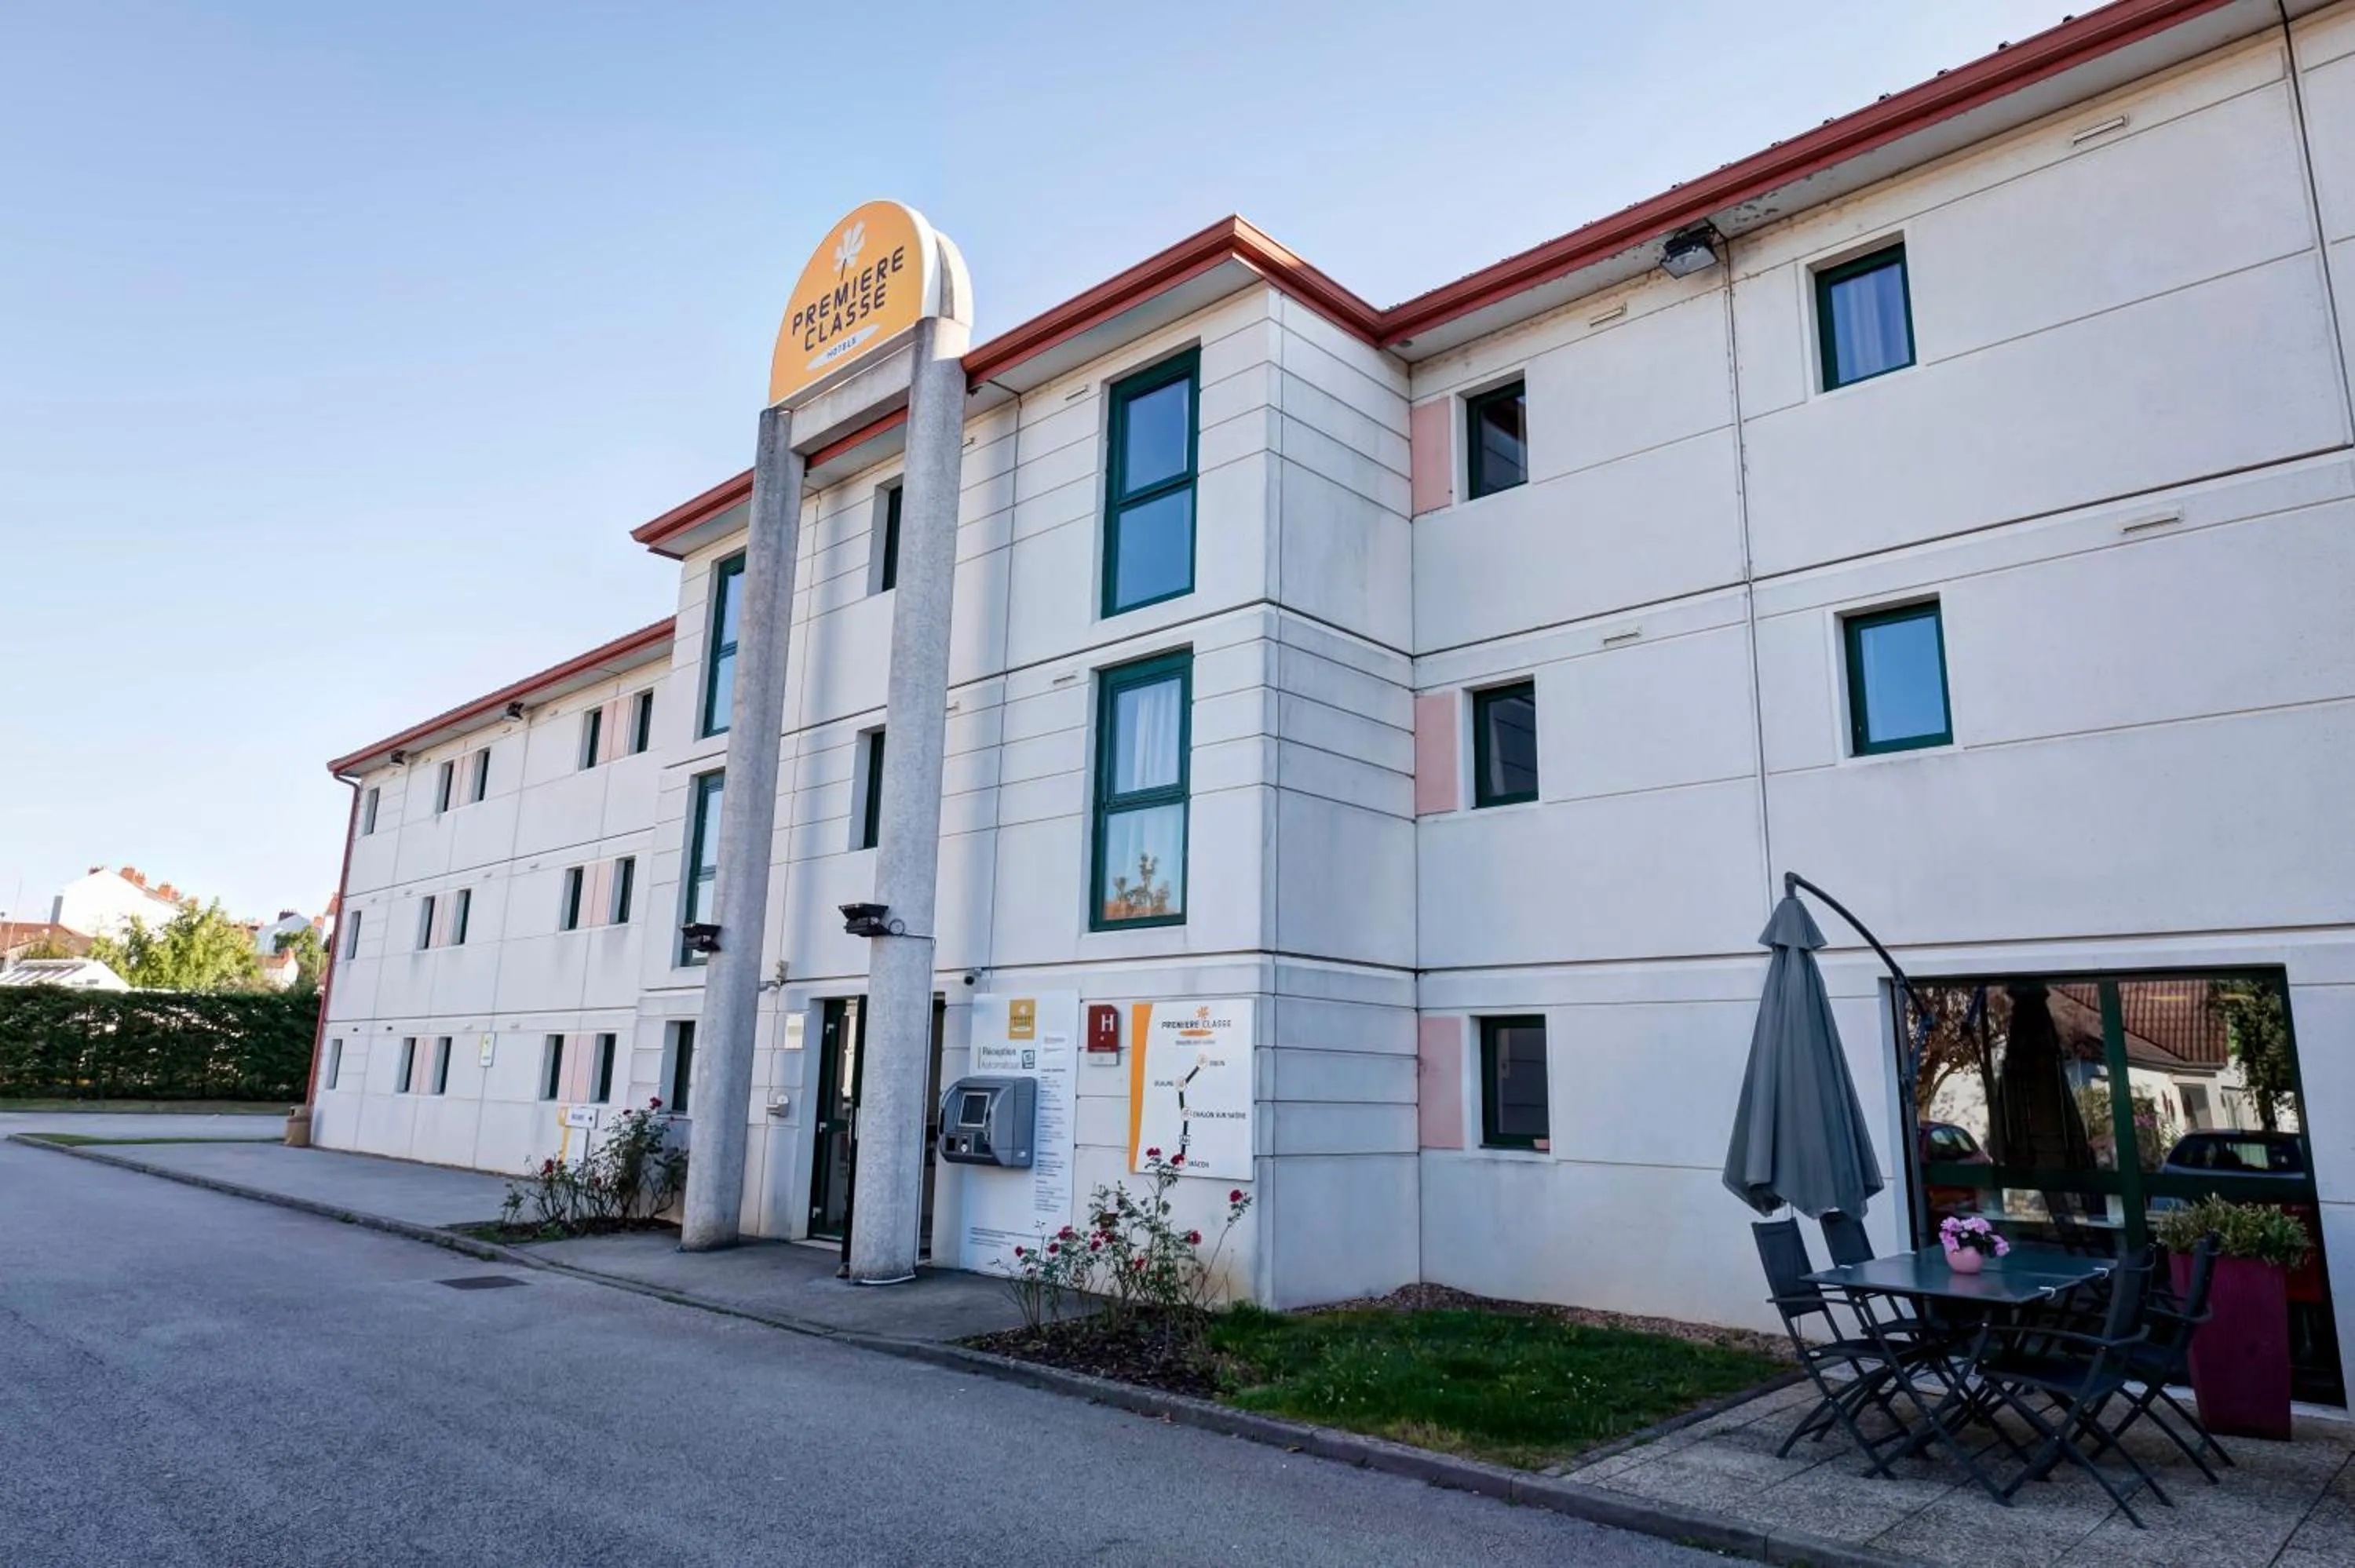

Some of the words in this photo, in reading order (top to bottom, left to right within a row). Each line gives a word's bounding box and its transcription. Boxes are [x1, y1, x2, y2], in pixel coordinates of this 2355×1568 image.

[791, 246, 904, 337] PREMIERE
[805, 283, 886, 352] CLASSE
[1101, 1013, 1114, 1032] H
